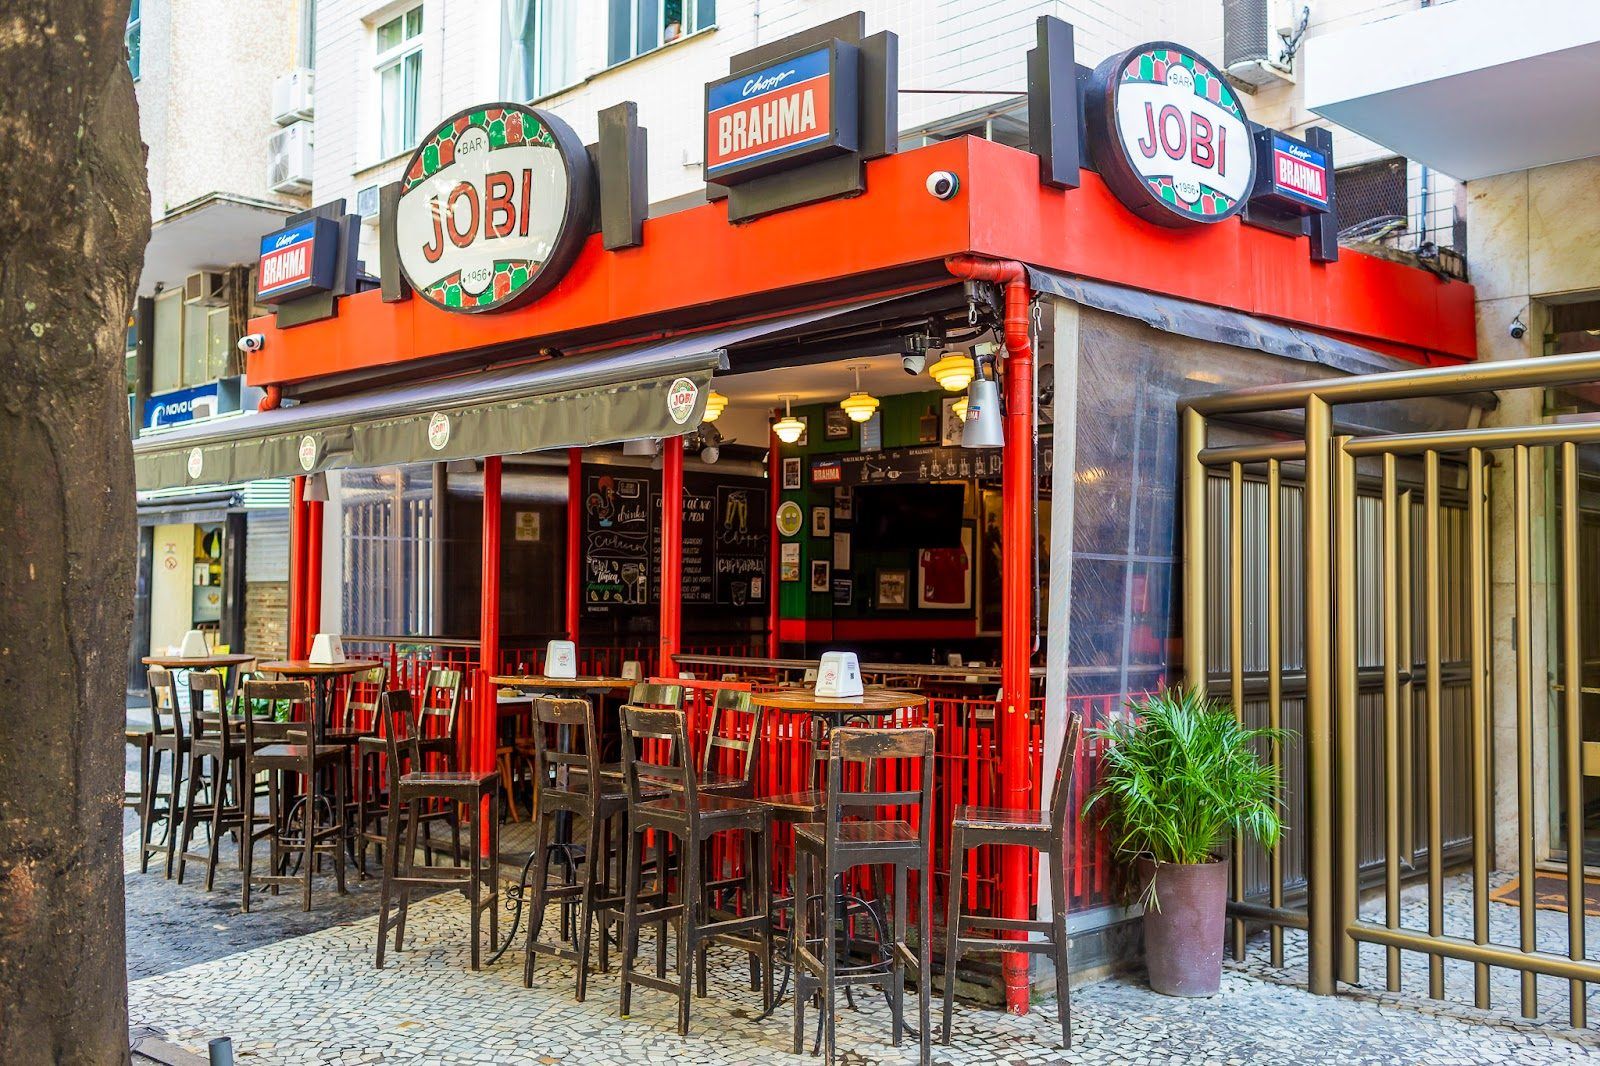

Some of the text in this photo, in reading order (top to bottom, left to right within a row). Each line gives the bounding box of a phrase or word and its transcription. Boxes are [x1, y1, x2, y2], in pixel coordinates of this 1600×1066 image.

[742, 69, 796, 97] Chopp
[1172, 73, 1190, 88] BAR
[718, 88, 817, 157] BRAHMA
[462, 137, 483, 156] BAR
[1138, 101, 1227, 178] JOBI
[1288, 144, 1312, 160] Chopp
[1279, 156, 1323, 197] BRAHMA
[1179, 181, 1196, 195] 1956
[422, 168, 533, 264] JOBI
[262, 246, 306, 288] BRAHMA
[467, 267, 488, 283] 1956
[674, 392, 694, 406] JOBI
[166, 401, 187, 416] NOVO
[813, 468, 840, 480] BRAHMA
[617, 504, 645, 522] drinks
